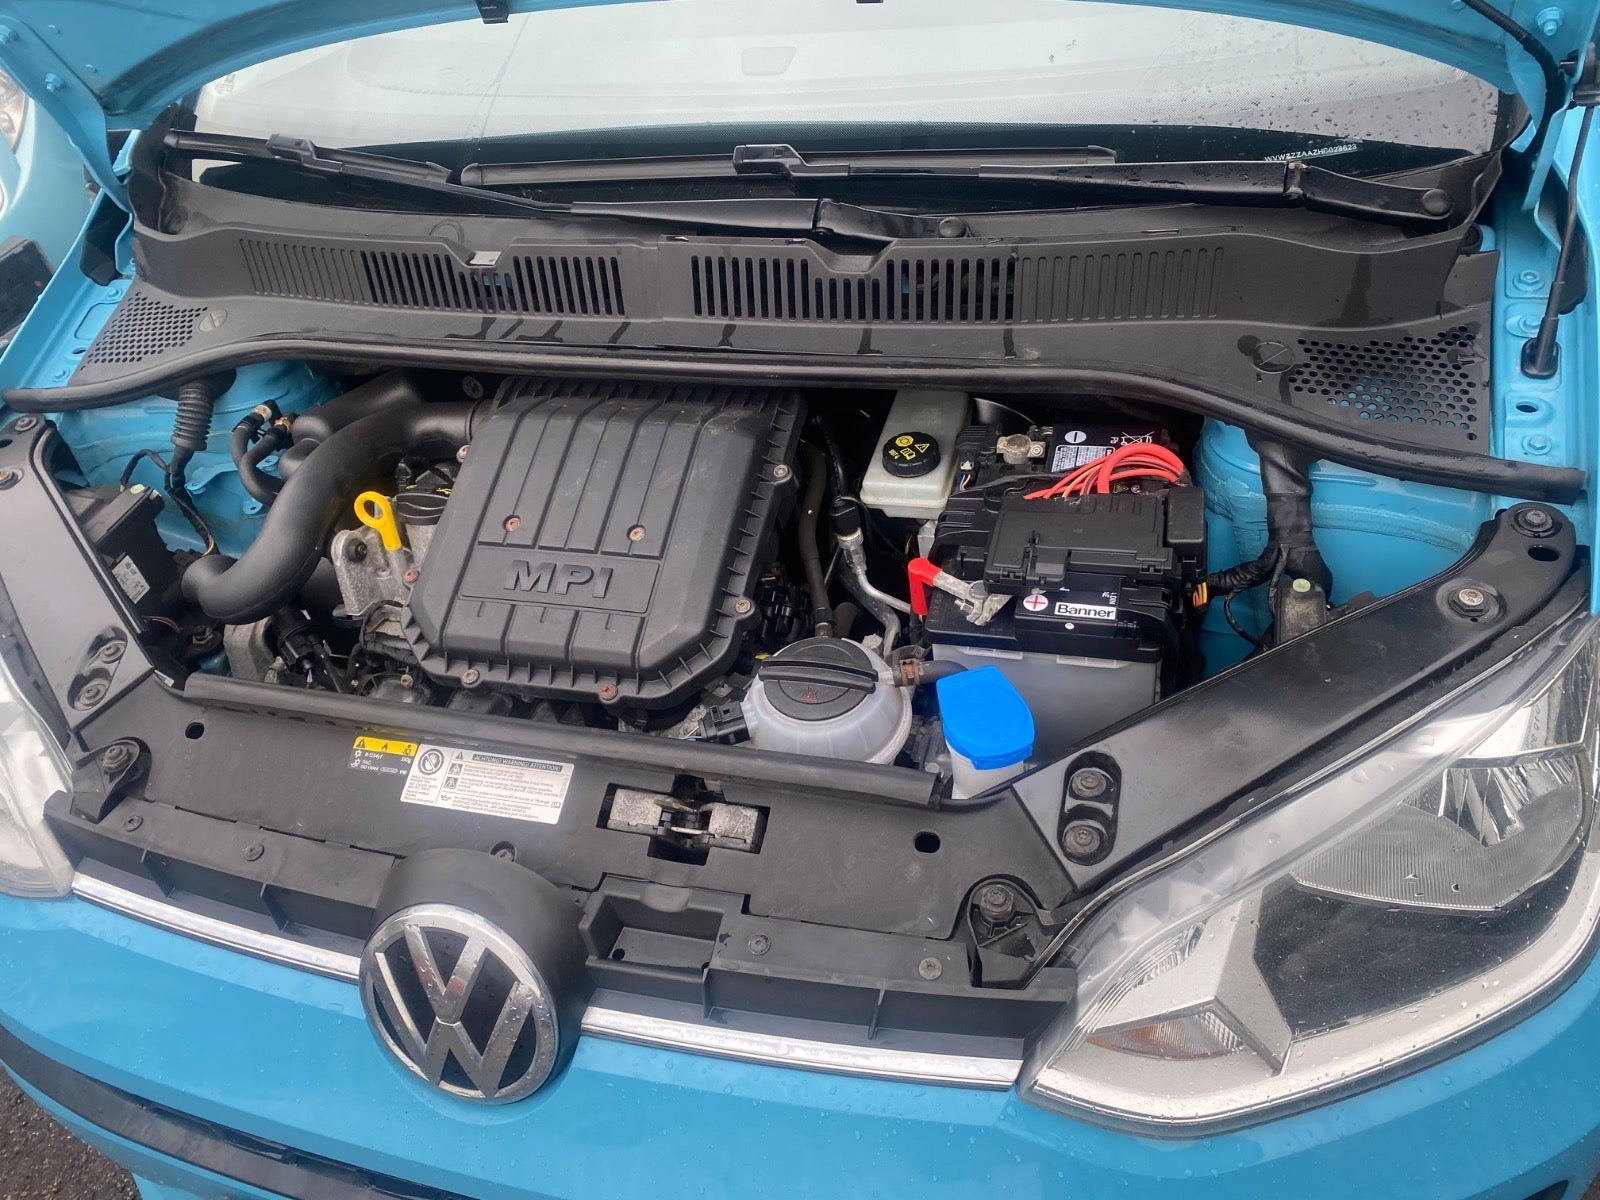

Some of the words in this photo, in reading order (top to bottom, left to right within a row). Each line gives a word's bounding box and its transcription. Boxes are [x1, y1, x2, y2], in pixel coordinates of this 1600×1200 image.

[503, 560, 614, 599] MPI
[1056, 603, 1114, 618] Banner
[368, 914, 550, 1101] VW
